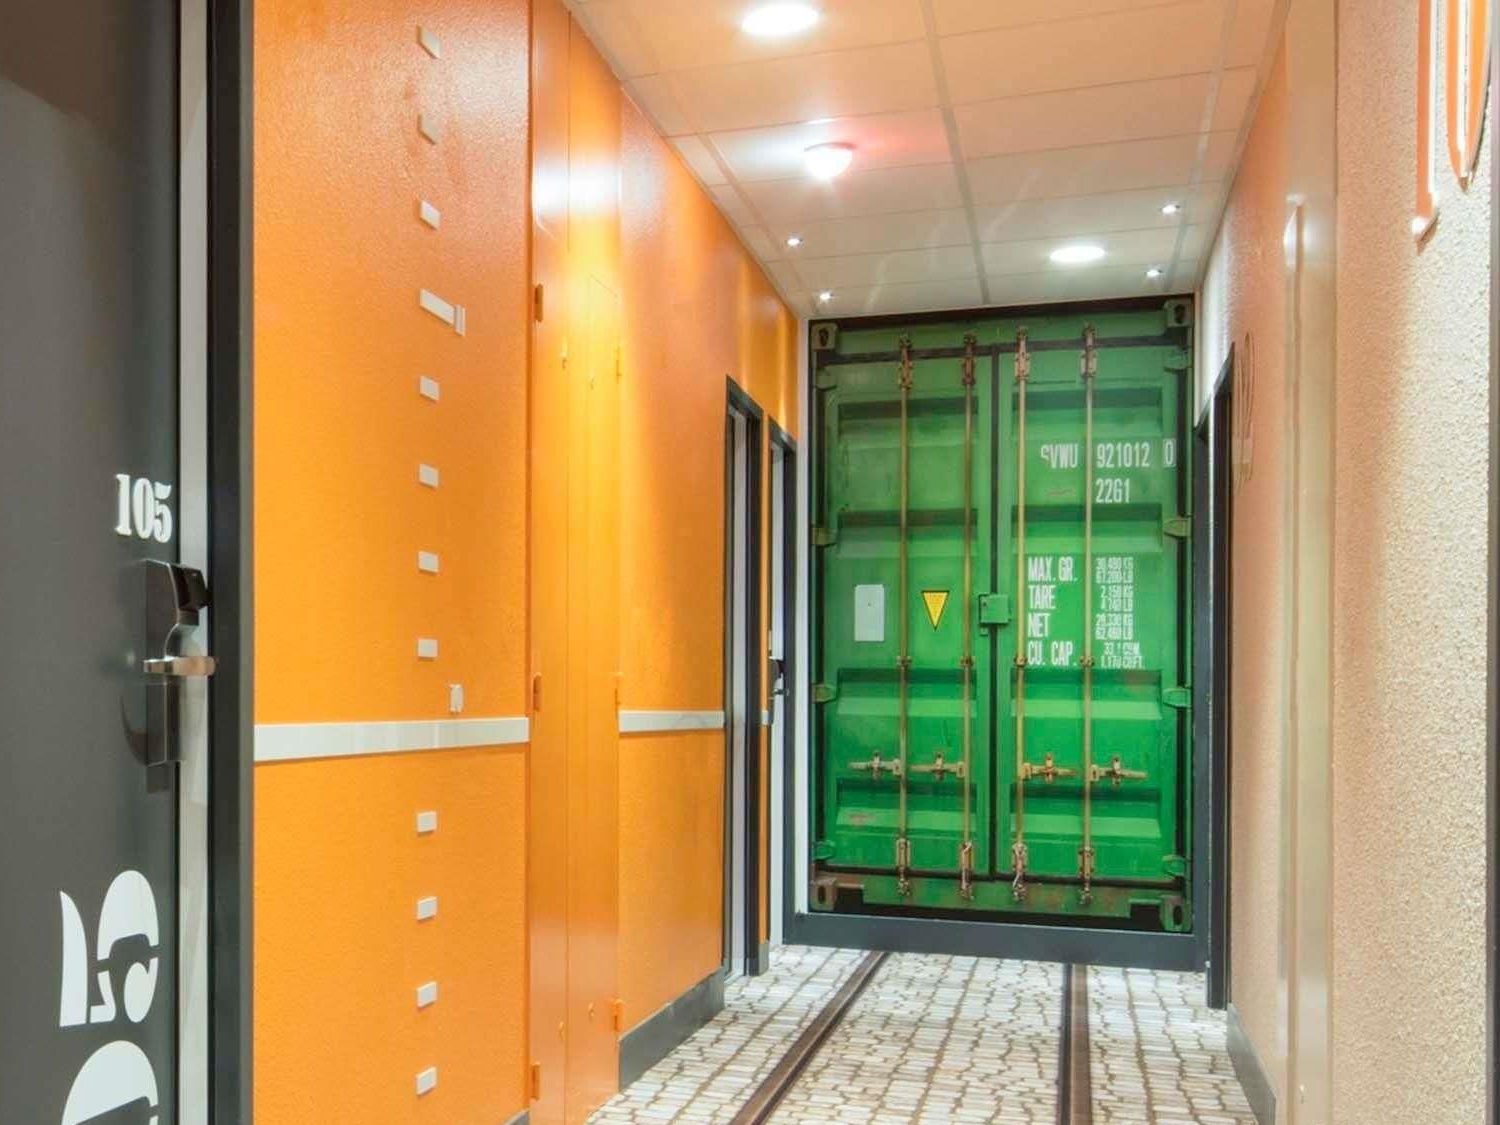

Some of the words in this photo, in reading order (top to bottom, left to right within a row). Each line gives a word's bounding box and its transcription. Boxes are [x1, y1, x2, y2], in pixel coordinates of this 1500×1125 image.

[1096, 442, 1150, 469] 921012
[114, 473, 173, 544] 105
[1027, 556, 1056, 582] MAX.
[1058, 556, 1078, 582] GR.
[1027, 585, 1056, 610] TARE
[1027, 612, 1050, 638] NET
[1027, 640, 1046, 666] CU.
[1051, 640, 1077, 667] CAP.
